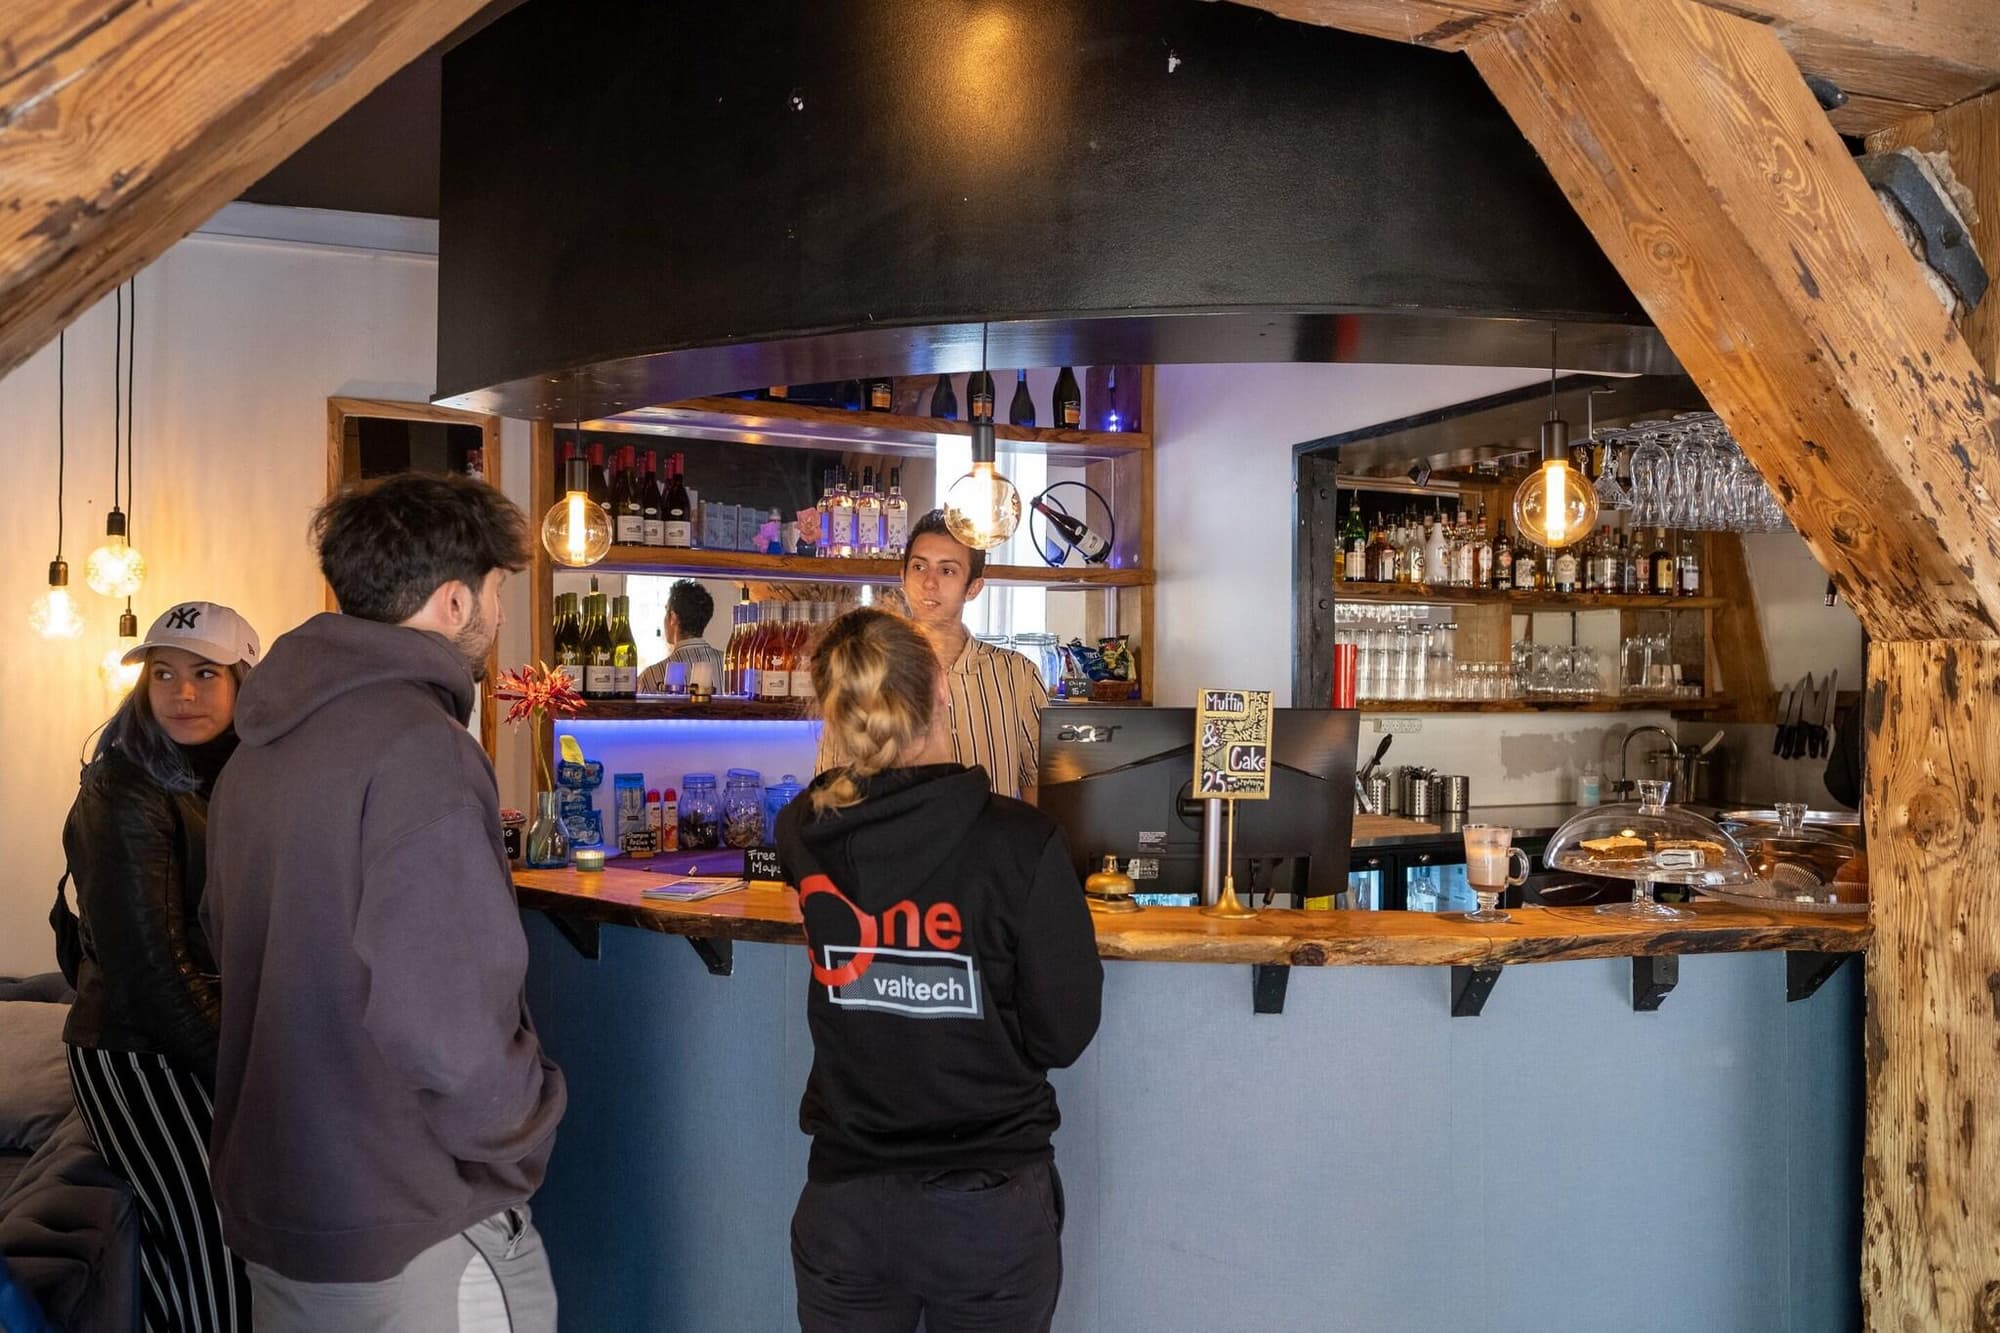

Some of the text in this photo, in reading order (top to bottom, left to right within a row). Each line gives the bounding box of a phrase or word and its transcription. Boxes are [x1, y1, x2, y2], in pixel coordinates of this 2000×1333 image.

[166, 607, 201, 629] NY
[1206, 693, 1244, 712] Muffin
[1057, 724, 1122, 742] acer
[1202, 723, 1220, 748] &
[747, 849, 776, 861] Free
[799, 874, 962, 987] One
[873, 975, 964, 1001] valtech
